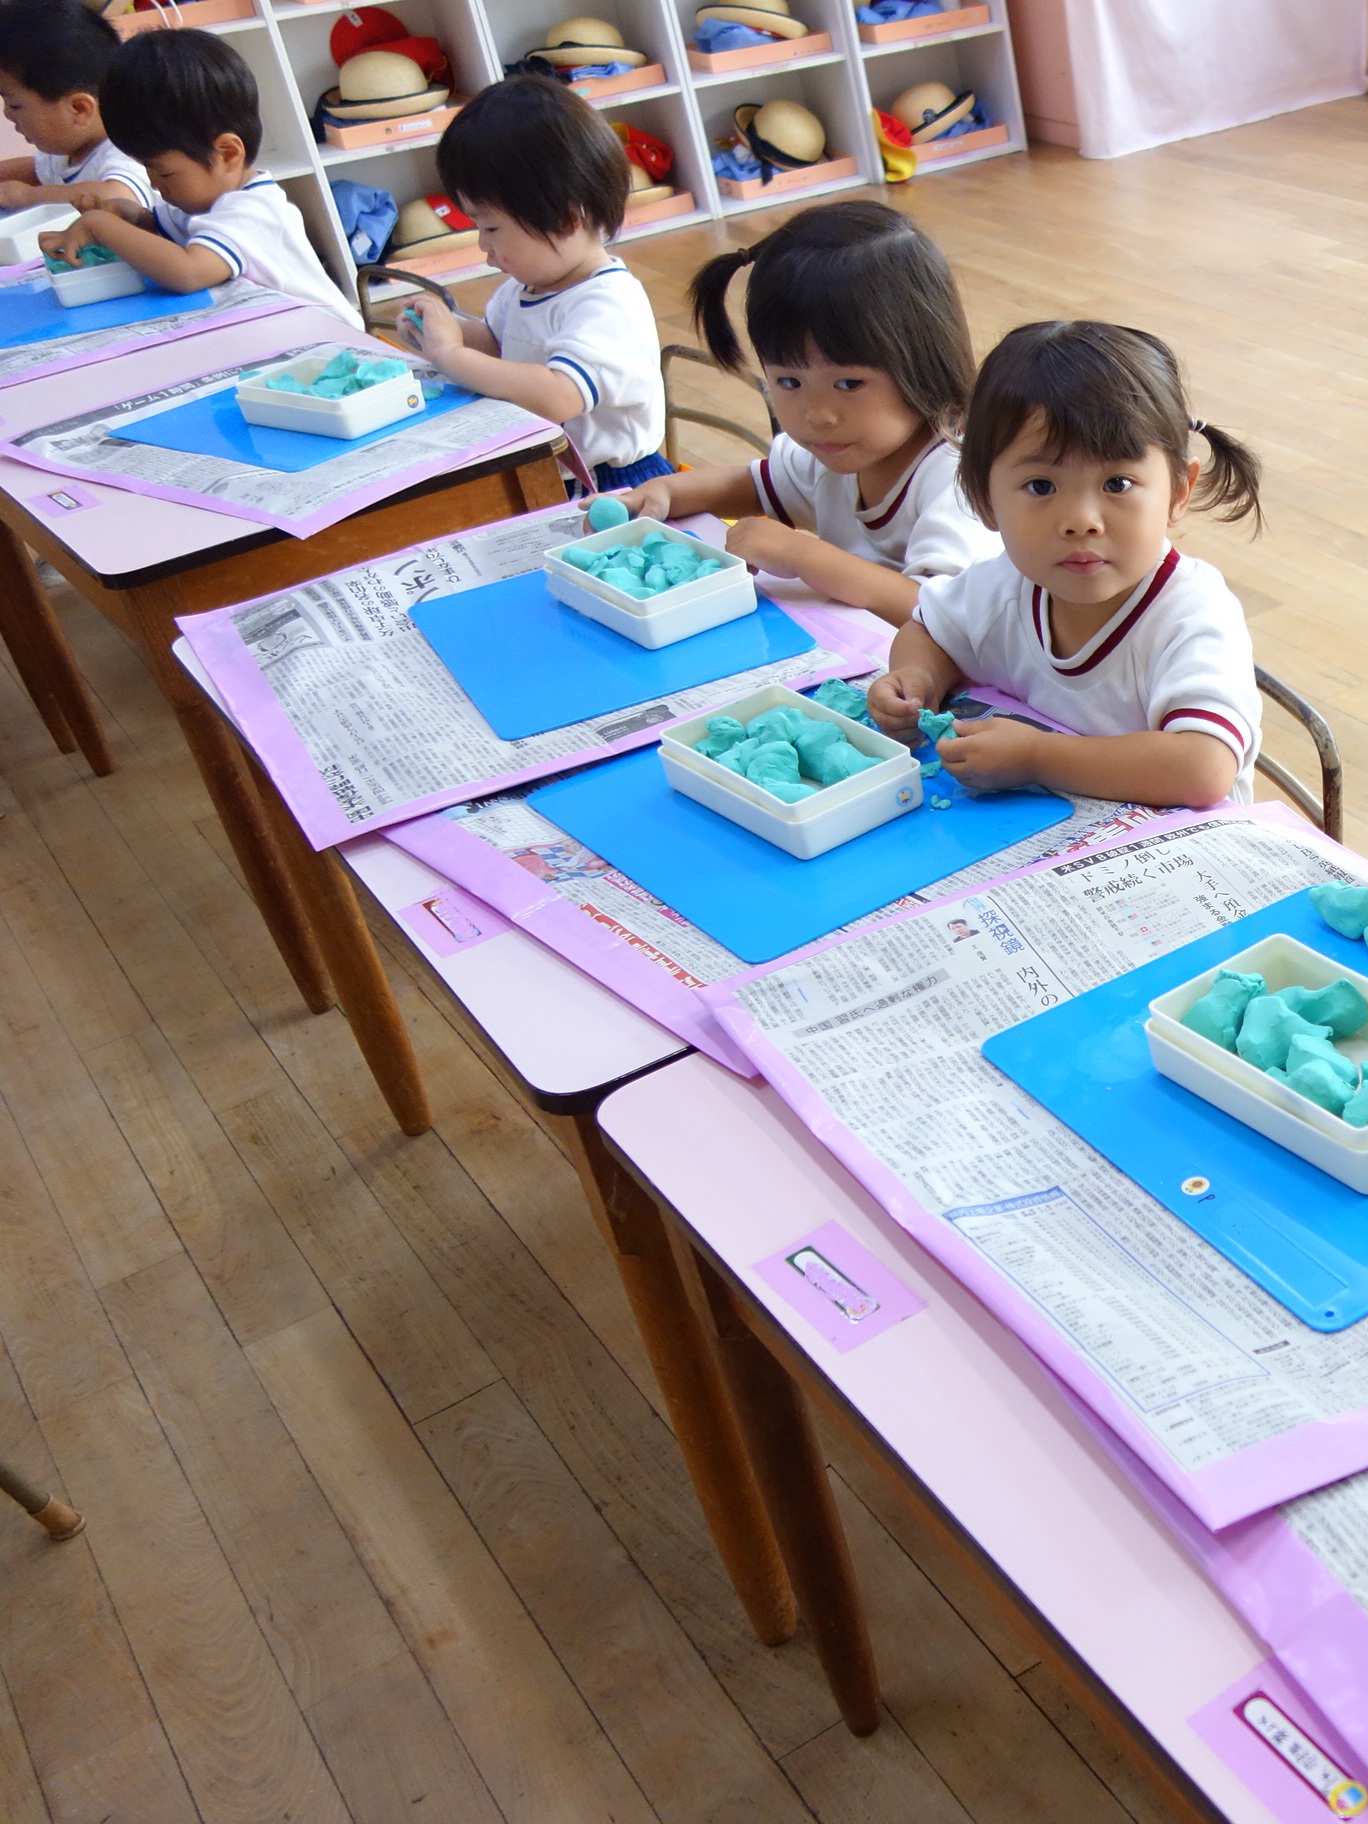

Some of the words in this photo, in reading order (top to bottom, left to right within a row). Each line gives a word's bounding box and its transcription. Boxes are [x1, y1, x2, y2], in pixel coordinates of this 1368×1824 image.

[1083, 854, 1194, 903] 警戒続く市場
[1016, 966, 1058, 1006] 内外の
[806, 1020, 833, 1034] 中国
